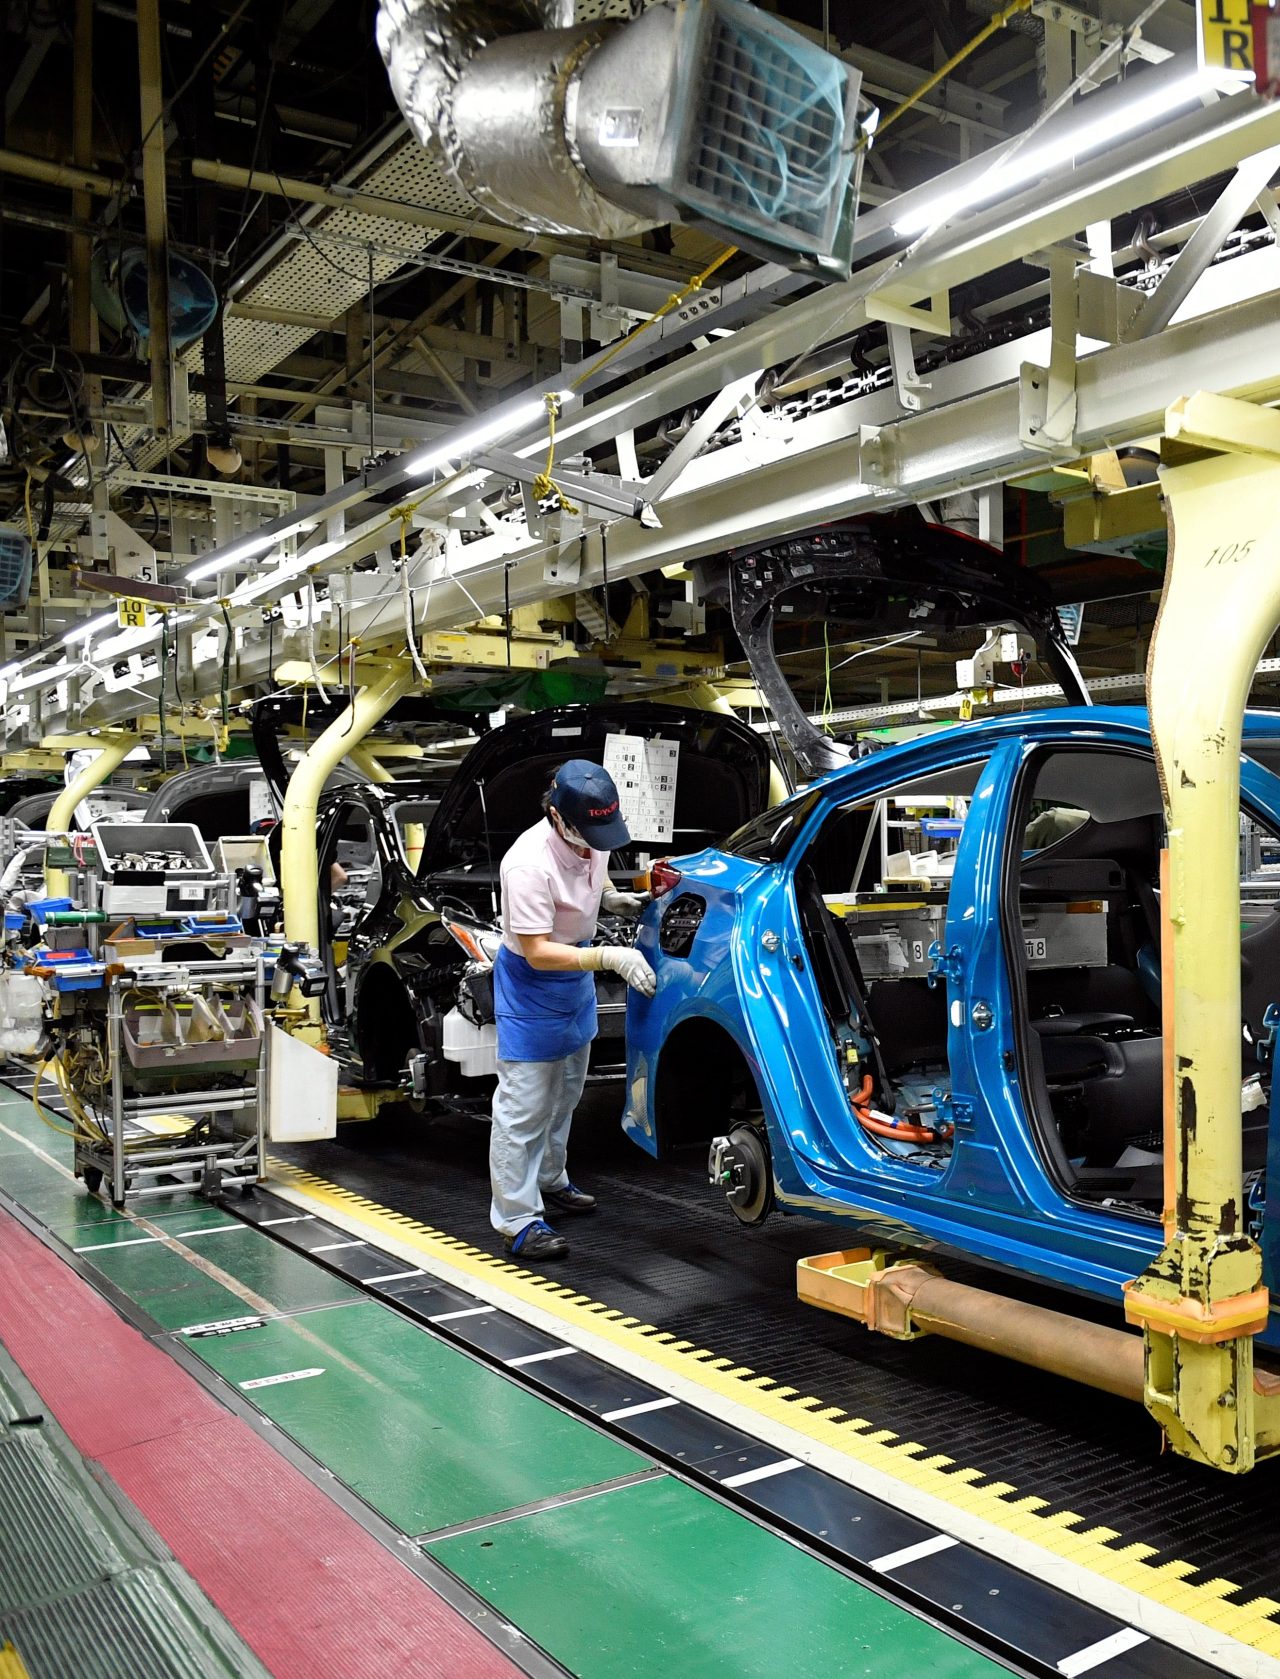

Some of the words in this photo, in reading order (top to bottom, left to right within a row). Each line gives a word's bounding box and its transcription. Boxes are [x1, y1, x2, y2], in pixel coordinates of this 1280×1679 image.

[1223, 30, 1252, 70] R
[1203, 539, 1257, 569] 105
[142, 567, 152, 581] 5
[122, 601, 142, 613] 10
[127, 614, 138, 626] R
[985, 670, 991, 681] 5
[914, 944, 922, 959] 8
